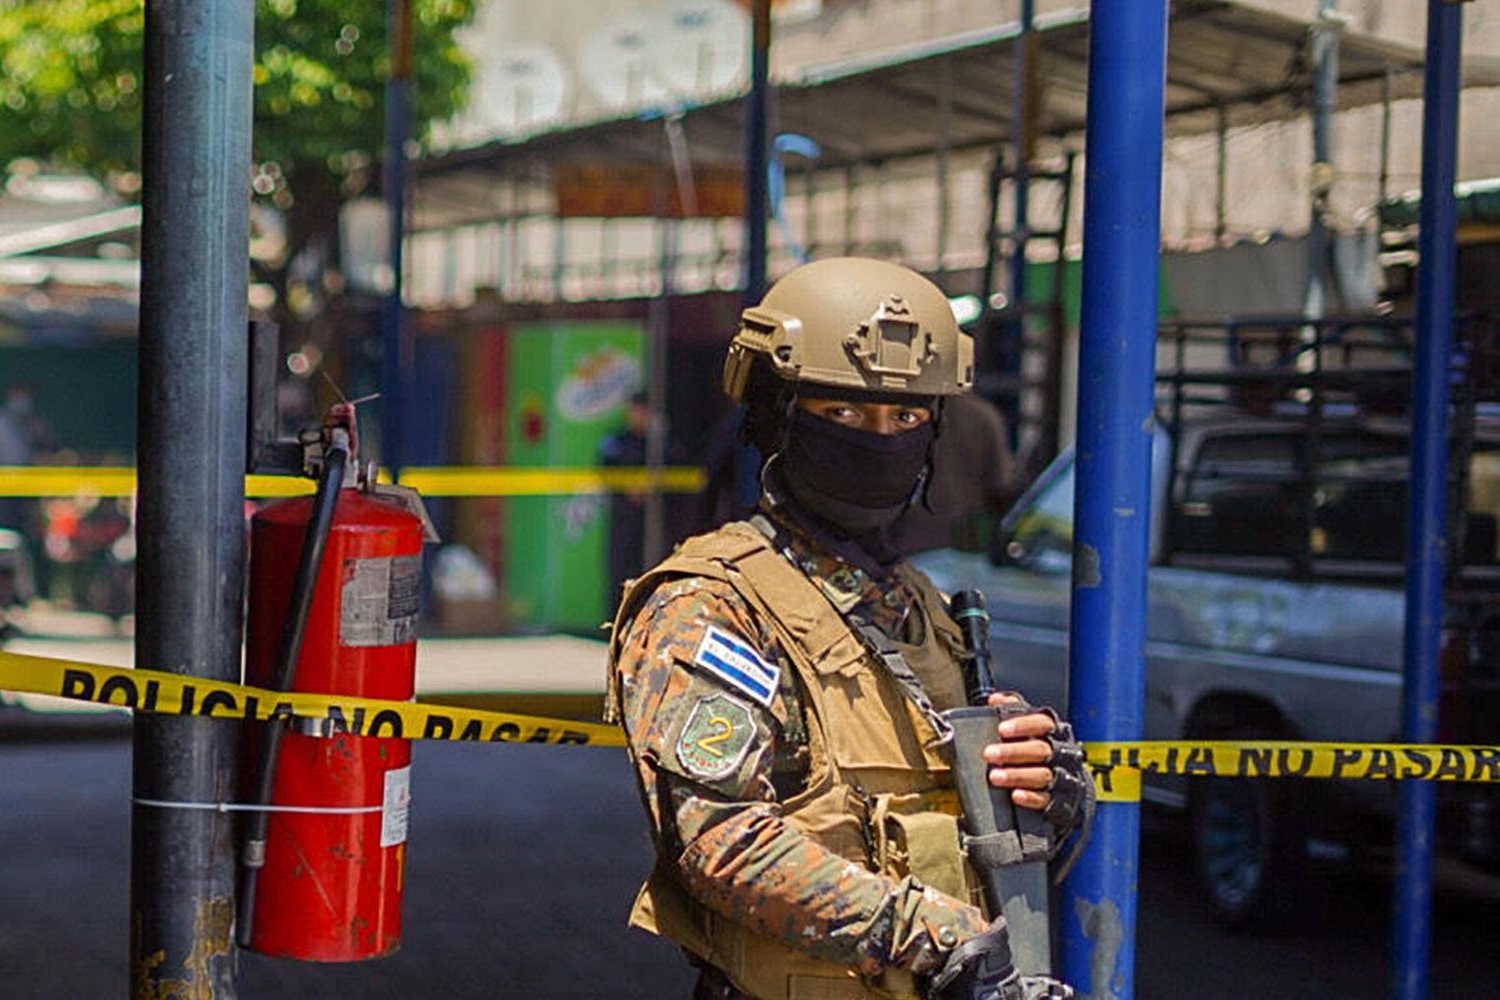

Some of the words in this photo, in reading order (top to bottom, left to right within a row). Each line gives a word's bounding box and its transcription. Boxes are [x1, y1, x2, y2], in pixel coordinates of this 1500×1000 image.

[60, 668, 294, 723] POLICIA
[321, 705, 404, 739] NO
[696, 716, 734, 758] 2
[1238, 748, 1314, 778] NO
[1332, 747, 1500, 781] PASAR
